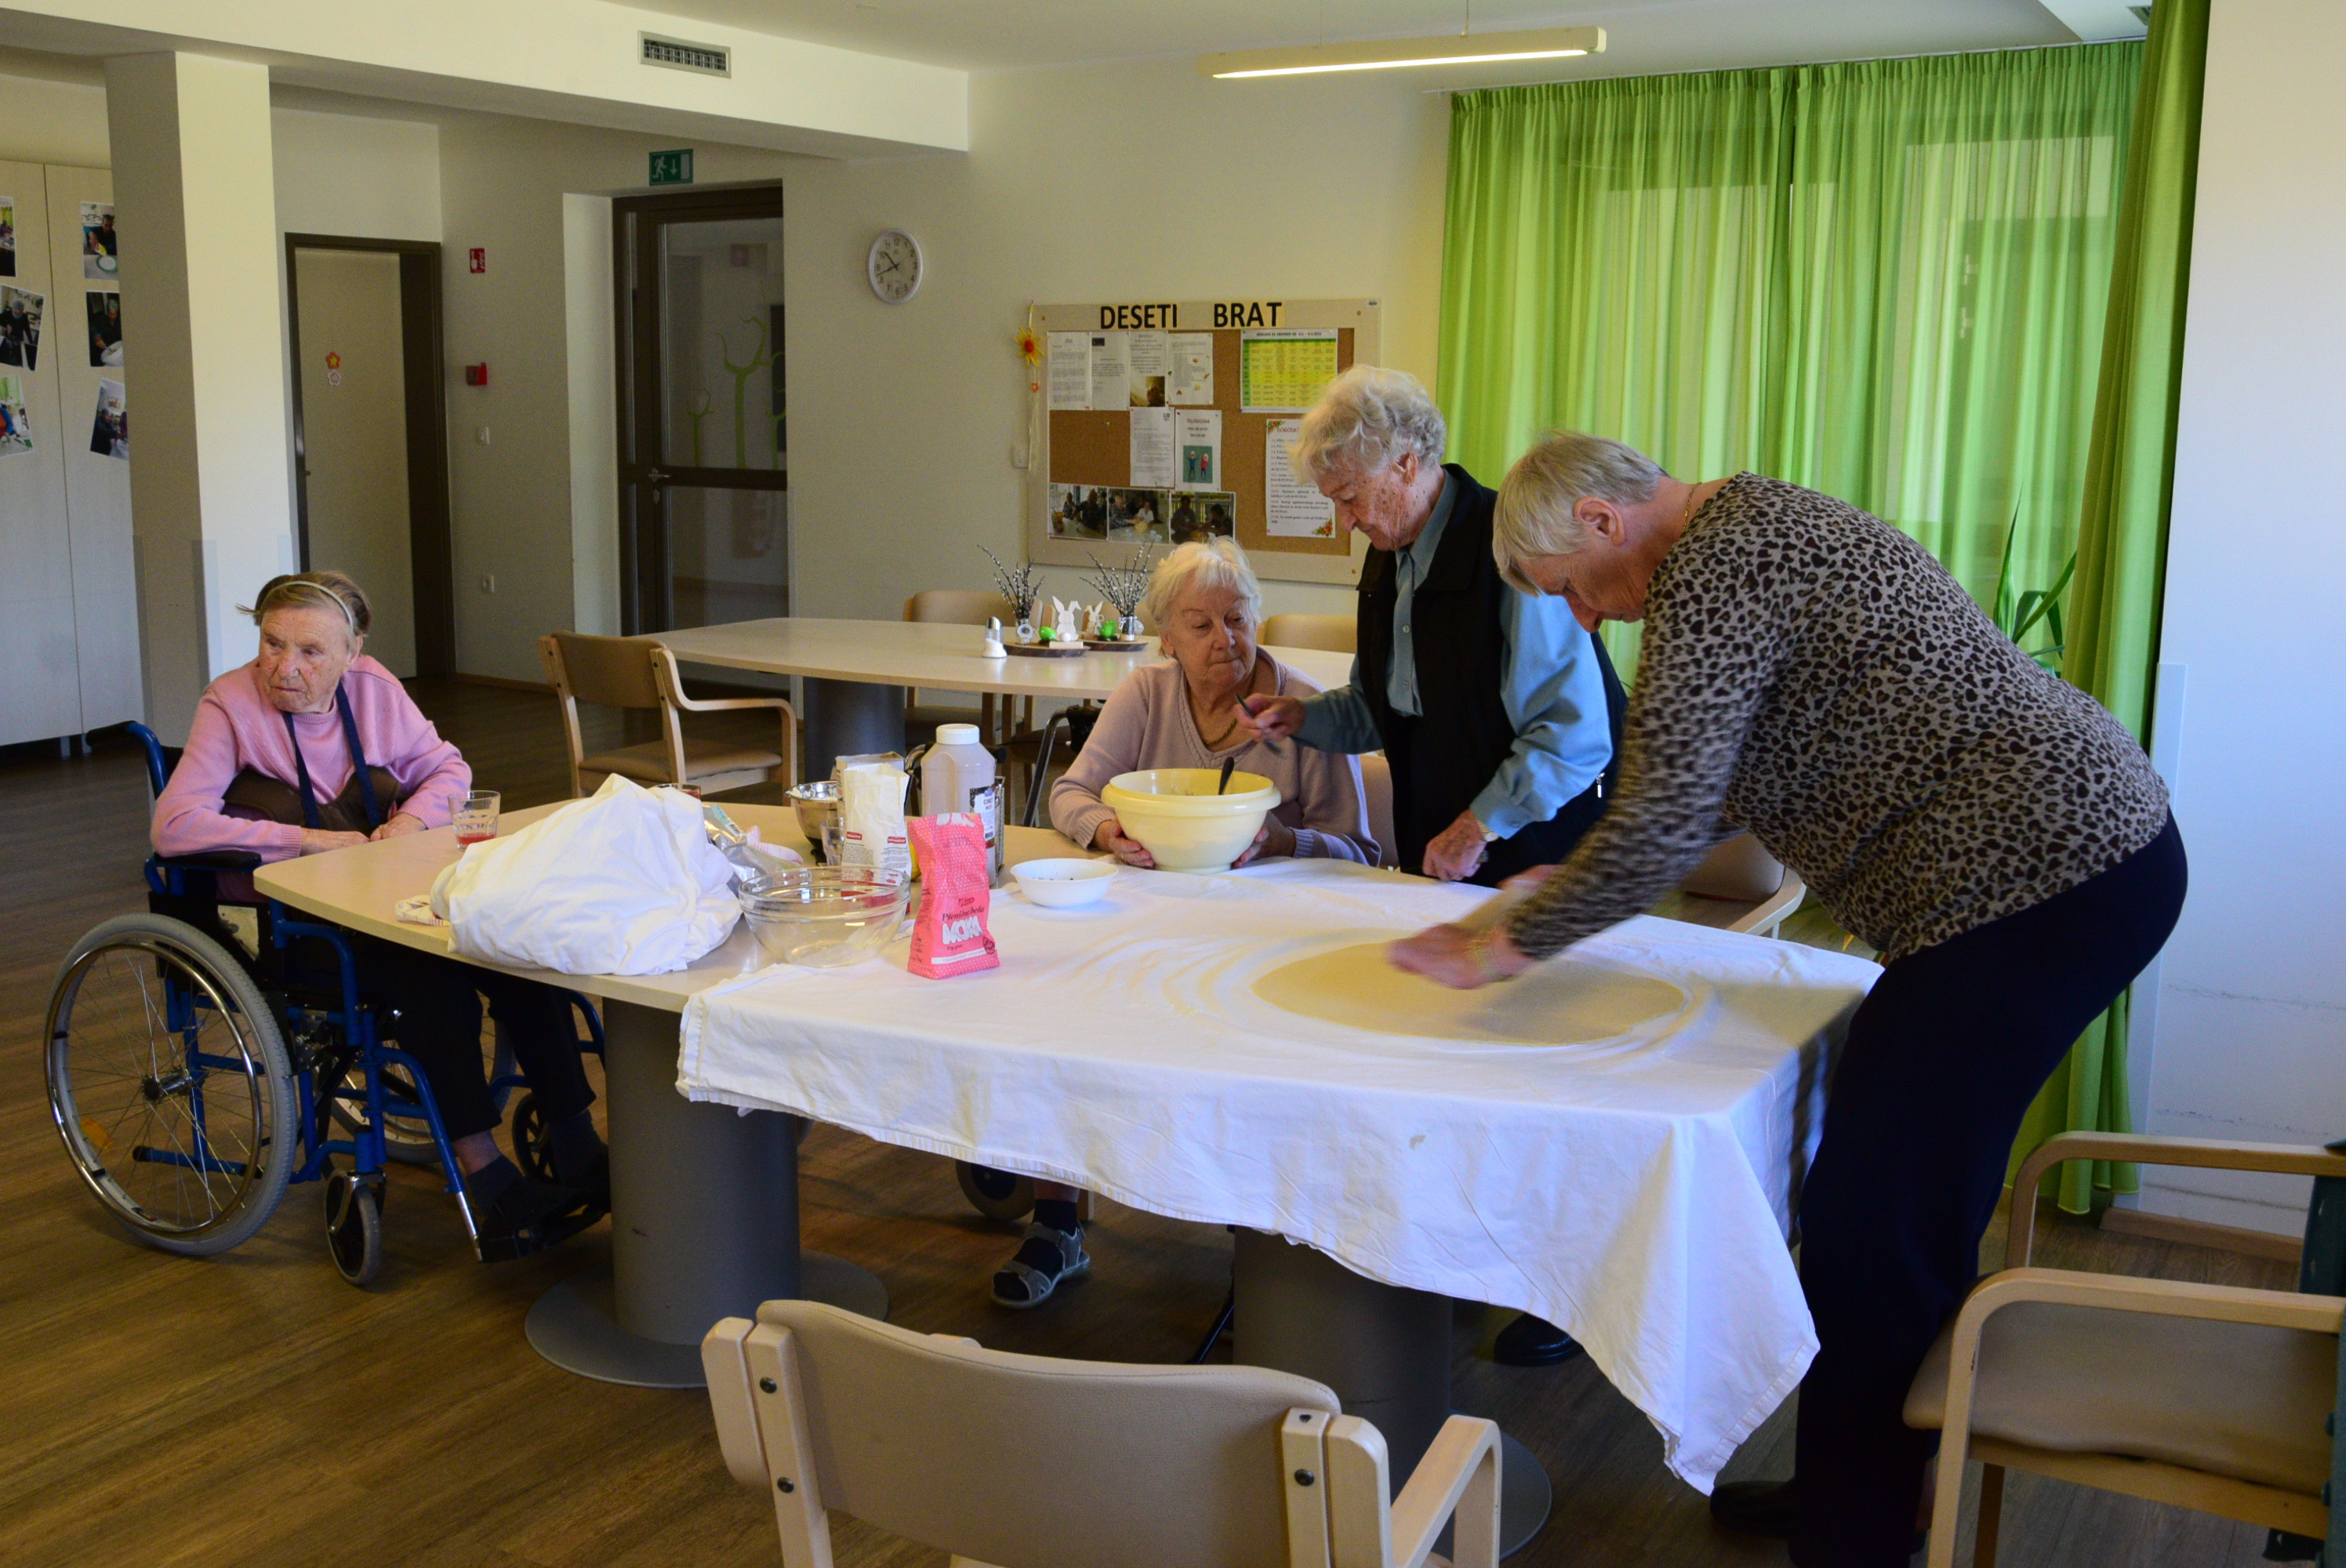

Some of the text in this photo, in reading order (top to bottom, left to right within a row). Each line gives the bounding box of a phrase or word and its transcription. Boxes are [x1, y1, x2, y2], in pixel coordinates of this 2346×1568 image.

[1100, 302, 1282, 329] DESETI BRAT
[942, 916, 983, 945] MOKA
